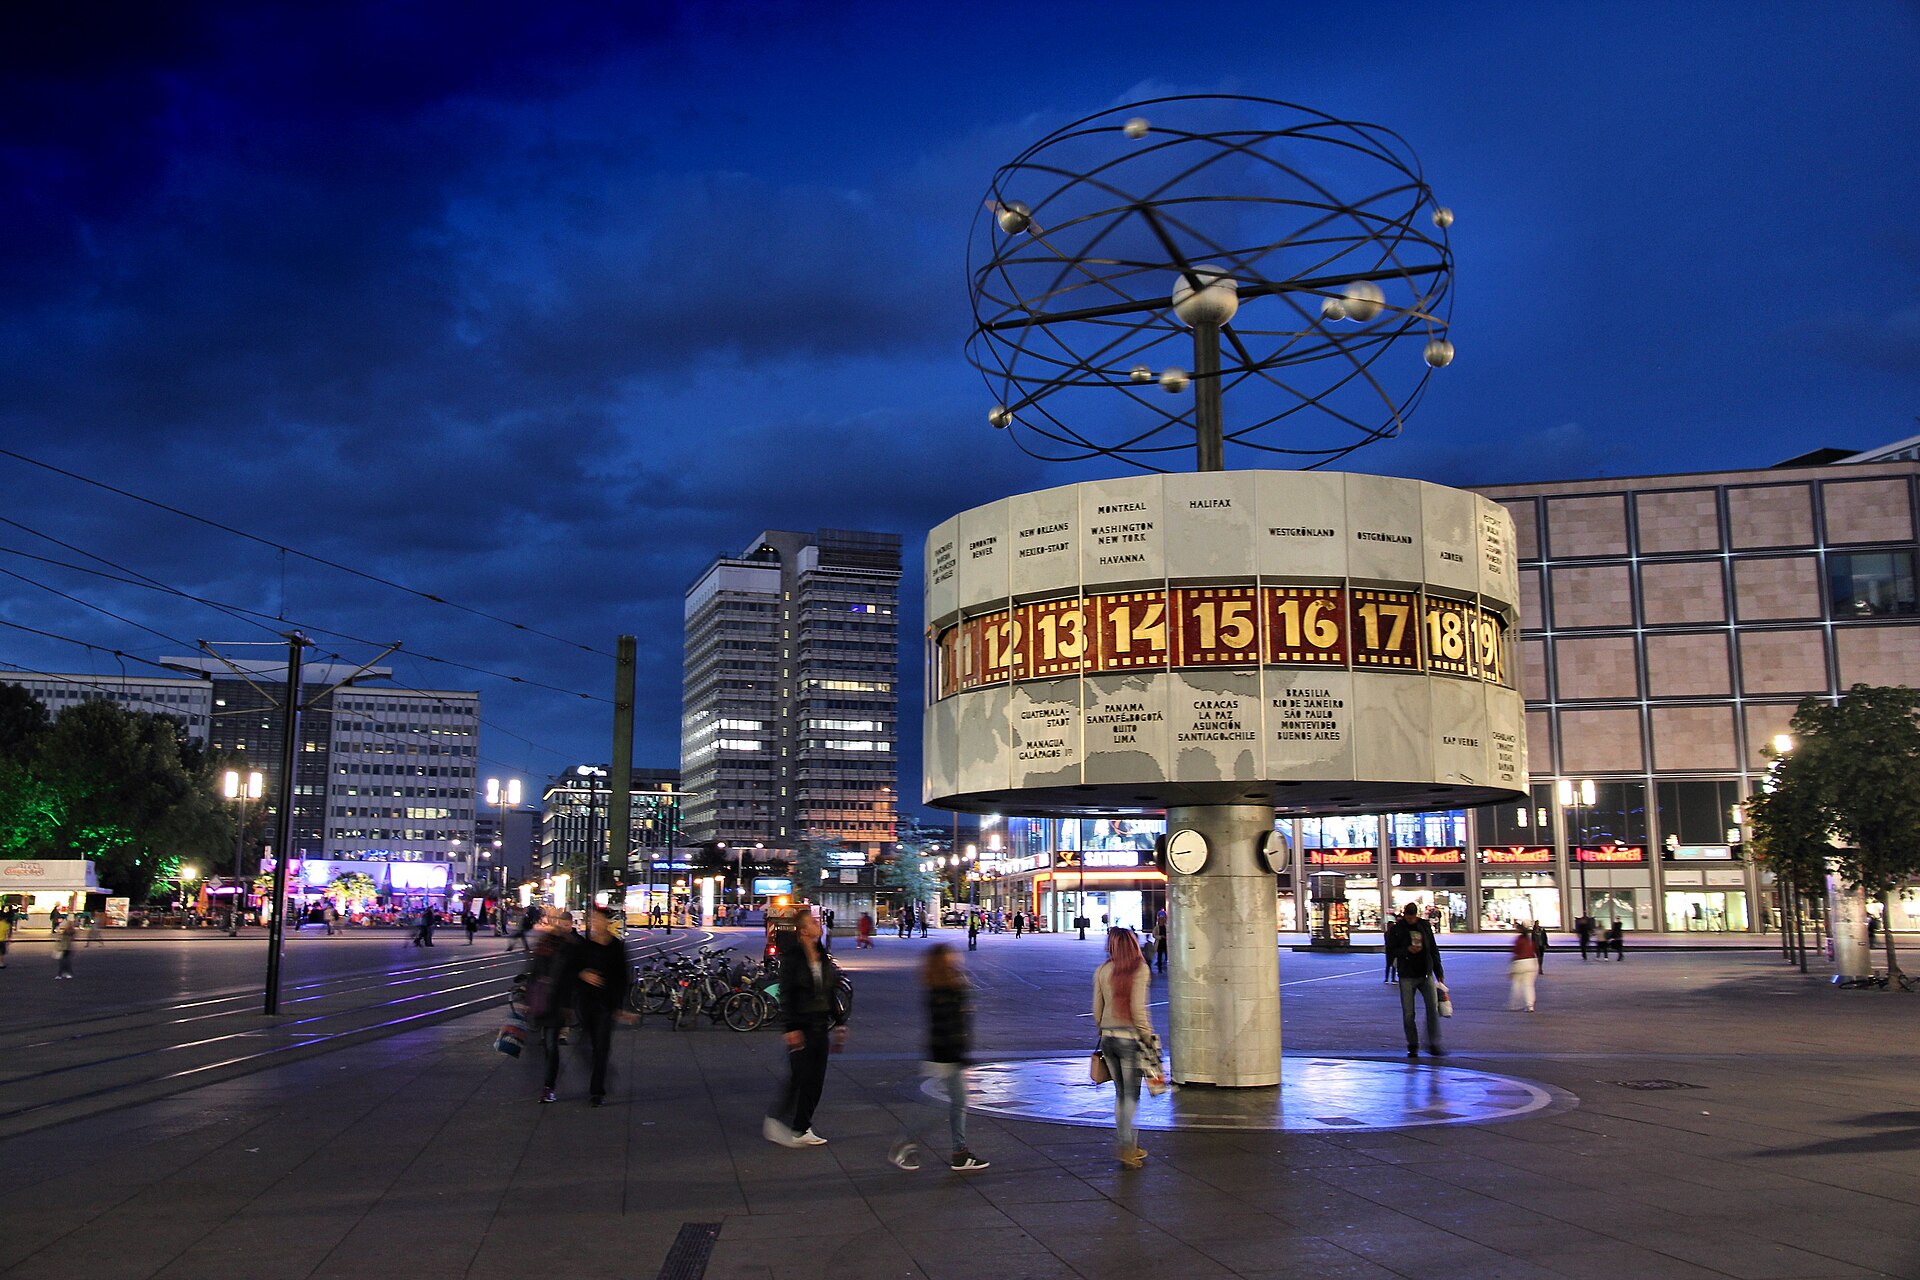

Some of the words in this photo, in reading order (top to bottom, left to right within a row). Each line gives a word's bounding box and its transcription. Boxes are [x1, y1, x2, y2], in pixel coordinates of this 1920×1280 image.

[1098, 502, 1146, 514] MONTREAL
[1189, 499, 1231, 508] HALIFAX
[1020, 528, 1035, 538] NEW
[1037, 522, 1069, 535] ORLEANS
[1091, 522, 1153, 535] WASHINGTON
[1268, 527, 1334, 537] WESTGRÖNLAND
[1098, 536, 1118, 545] NEW
[1122, 533, 1146, 543] YORK
[1357, 531, 1412, 544] OSTGRÖNLAND
[969, 536, 997, 551] EDMONTON
[972, 547, 993, 559] DENVER
[1019, 542, 1070, 558] MEXIKO-STADT
[1100, 554, 1145, 565] HAVANNA
[985, 620, 1023, 669] 12
[1038, 610, 1088, 660] 13
[1108, 603, 1166, 653] 14
[1192, 601, 1254, 648] 15
[1278, 600, 1339, 648] 16
[1358, 603, 1409, 651] 17
[1426, 610, 1464, 660] 18
[1471, 619, 1494, 666] 19
[1286, 689, 1330, 698] BRASILIA
[1105, 703, 1144, 713] PANAMA
[1193, 700, 1238, 710] CARACAS
[1272, 699, 1287, 708] RIO
[1290, 700, 1301, 708] DE
[1303, 700, 1343, 709] JANEIRO
[1021, 708, 1070, 720] GUATEMALA-
[1198, 711, 1211, 720] LA
[1215, 710, 1233, 720] PAZ
[1284, 708, 1301, 719] SÃO
[1305, 710, 1333, 719] PAULO
[1046, 718, 1070, 728] STADT
[1192, 719, 1241, 731] ASUNCIÓN
[1281, 721, 1336, 730] MONTEVIDEO
[1113, 724, 1137, 733] QUITO
[1114, 735, 1136, 744] LIMA
[1277, 732, 1312, 741] BUENOS
[1314, 732, 1340, 741] AIRES
[1026, 739, 1064, 749] MANAGUA
